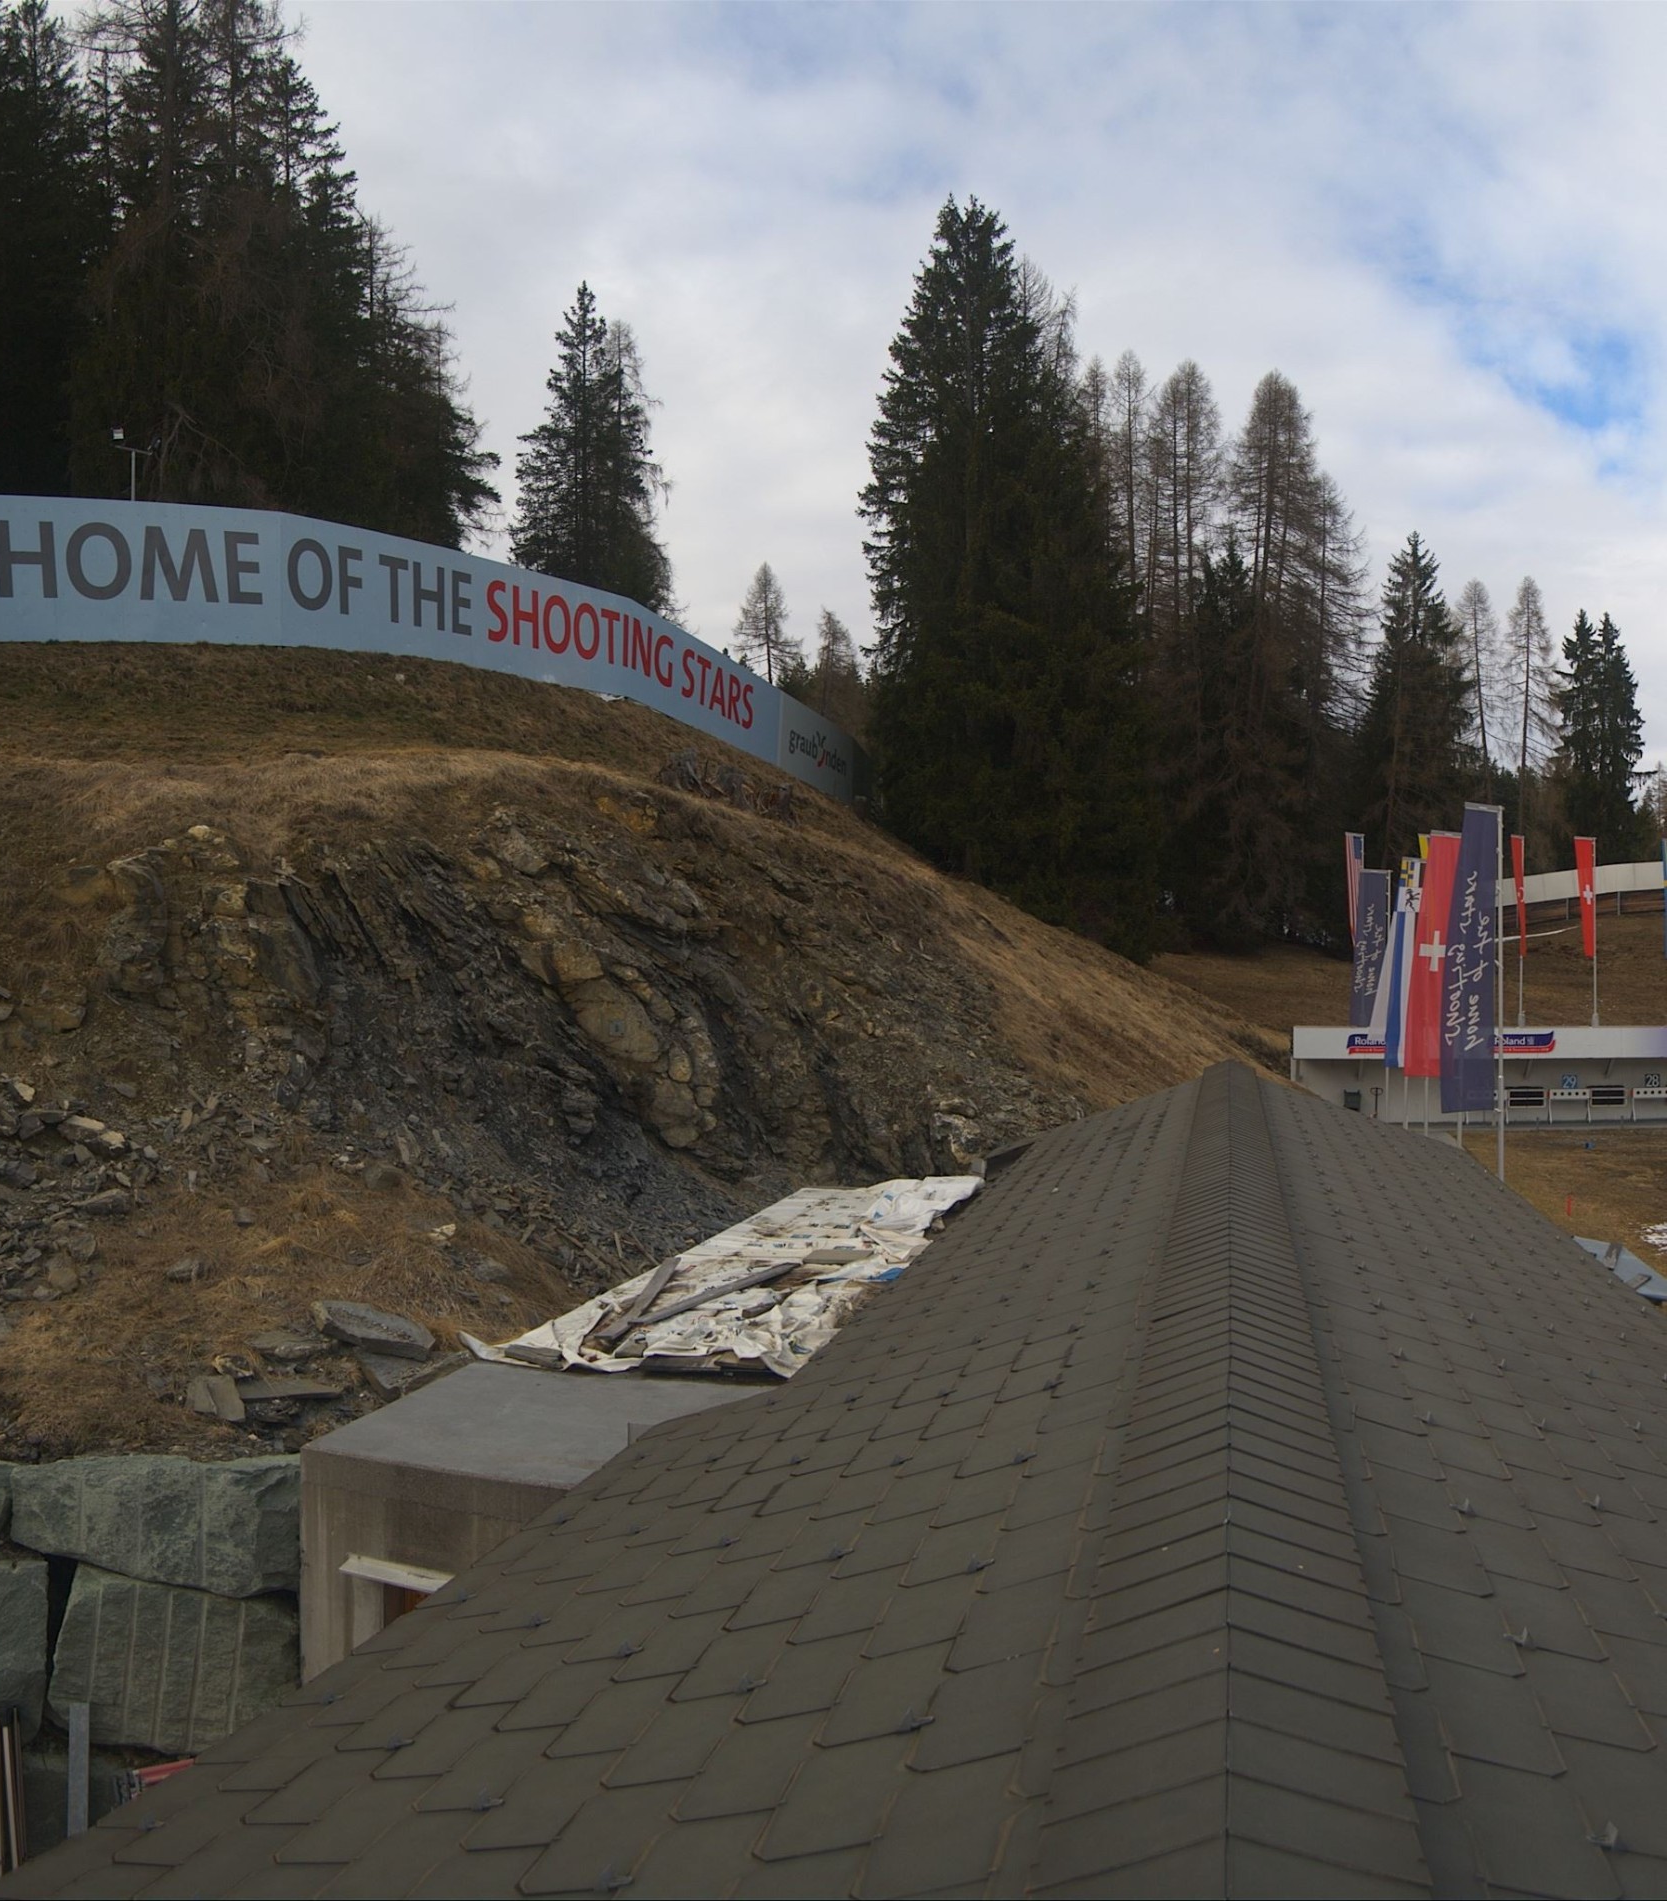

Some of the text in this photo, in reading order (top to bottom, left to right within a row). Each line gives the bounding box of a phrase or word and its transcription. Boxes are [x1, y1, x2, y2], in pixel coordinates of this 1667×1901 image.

[286, 538, 363, 615] OF
[377, 553, 472, 636] THE
[485, 579, 674, 690] SHOOTING
[680, 648, 754, 732] STARS
[1562, 1075, 1577, 1088] 29
[1645, 1074, 1660, 1087] 28
